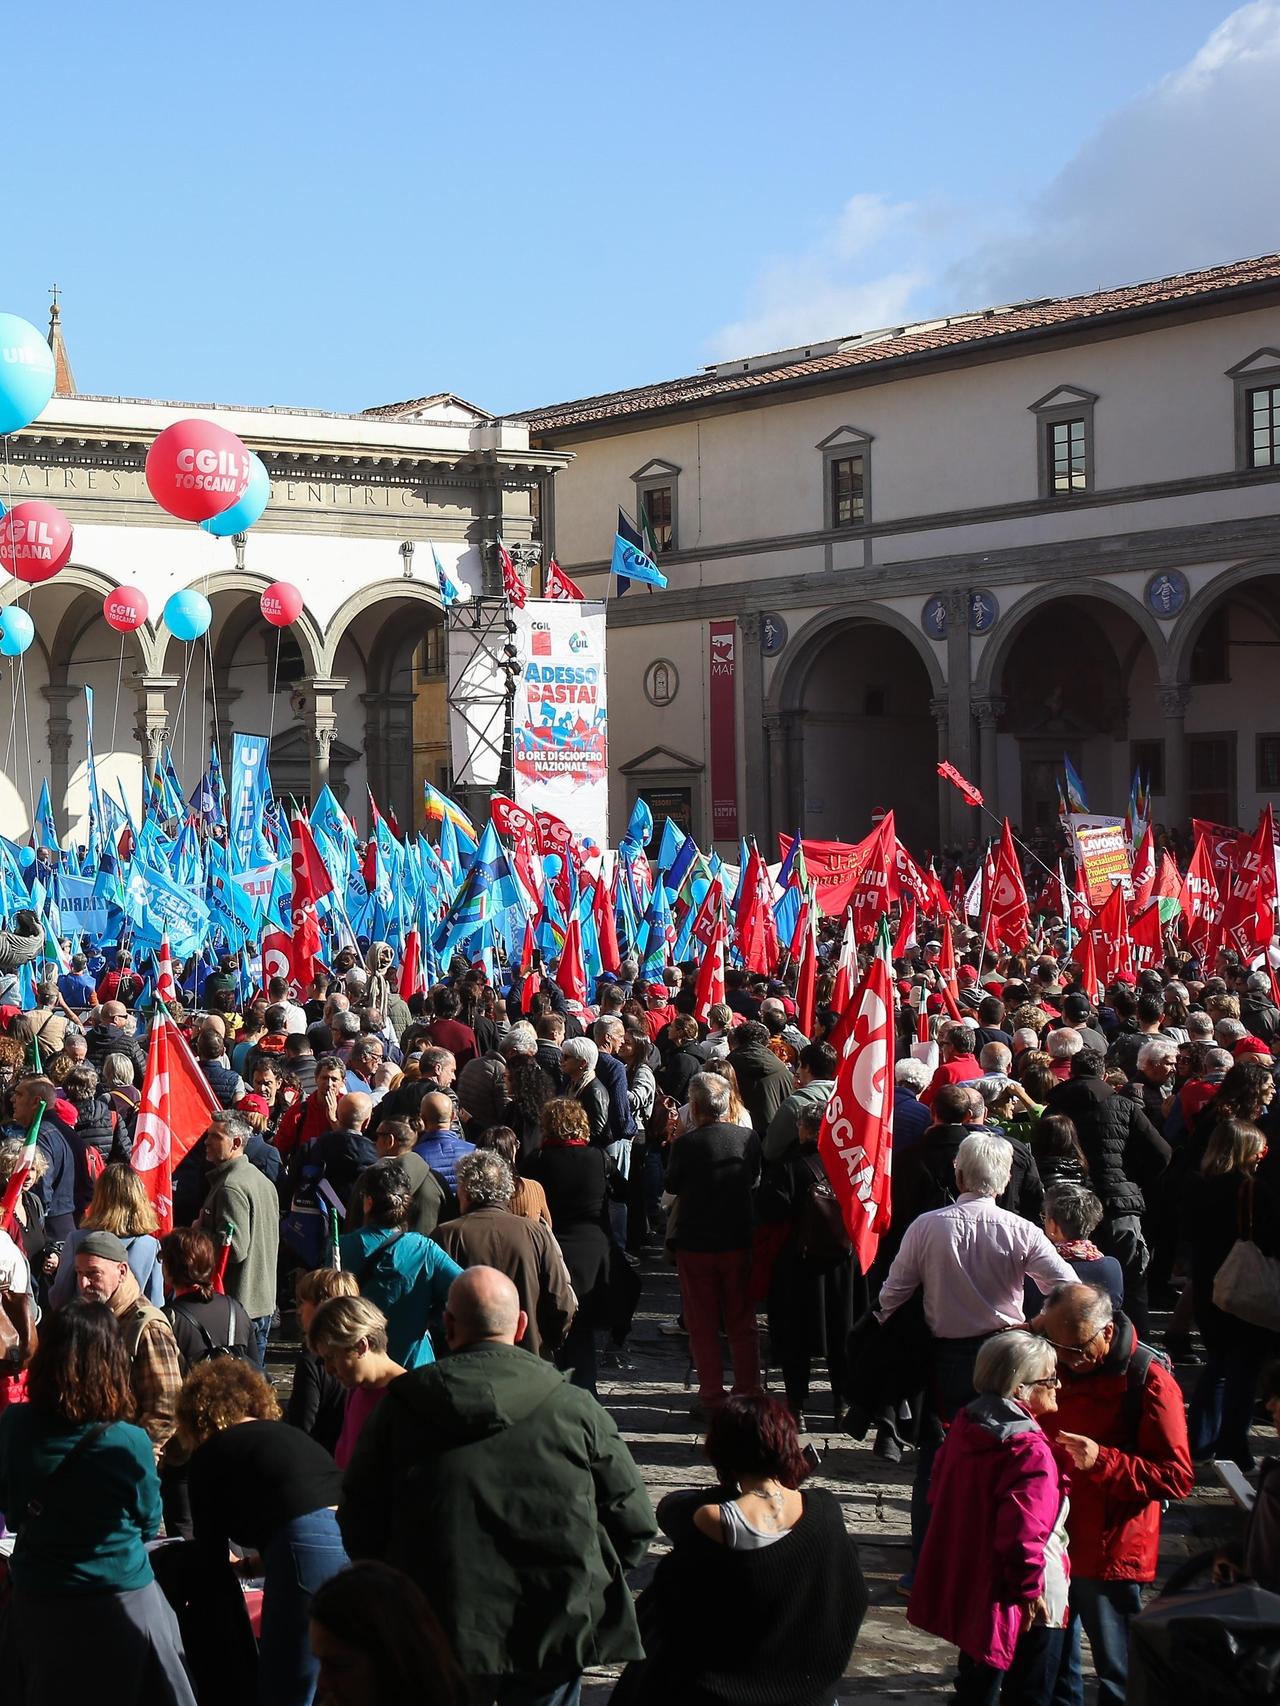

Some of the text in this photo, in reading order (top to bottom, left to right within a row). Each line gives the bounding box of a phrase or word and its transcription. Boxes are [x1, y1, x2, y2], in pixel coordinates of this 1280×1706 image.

[176, 448, 239, 477] CGIL
[175, 473, 237, 493] TOSCANA
[109, 602, 137, 619] CGIL
[531, 621, 551, 631] CGIL
[575, 640, 589, 649] UIL
[524, 662, 599, 684] ADESSO
[527, 684, 597, 705] BASTA!
[518, 751, 603, 762] 8 ORE DI SCIOPERO
[535, 761, 589, 772] NAZIONALE
[1085, 853, 1125, 869] Socialismo
